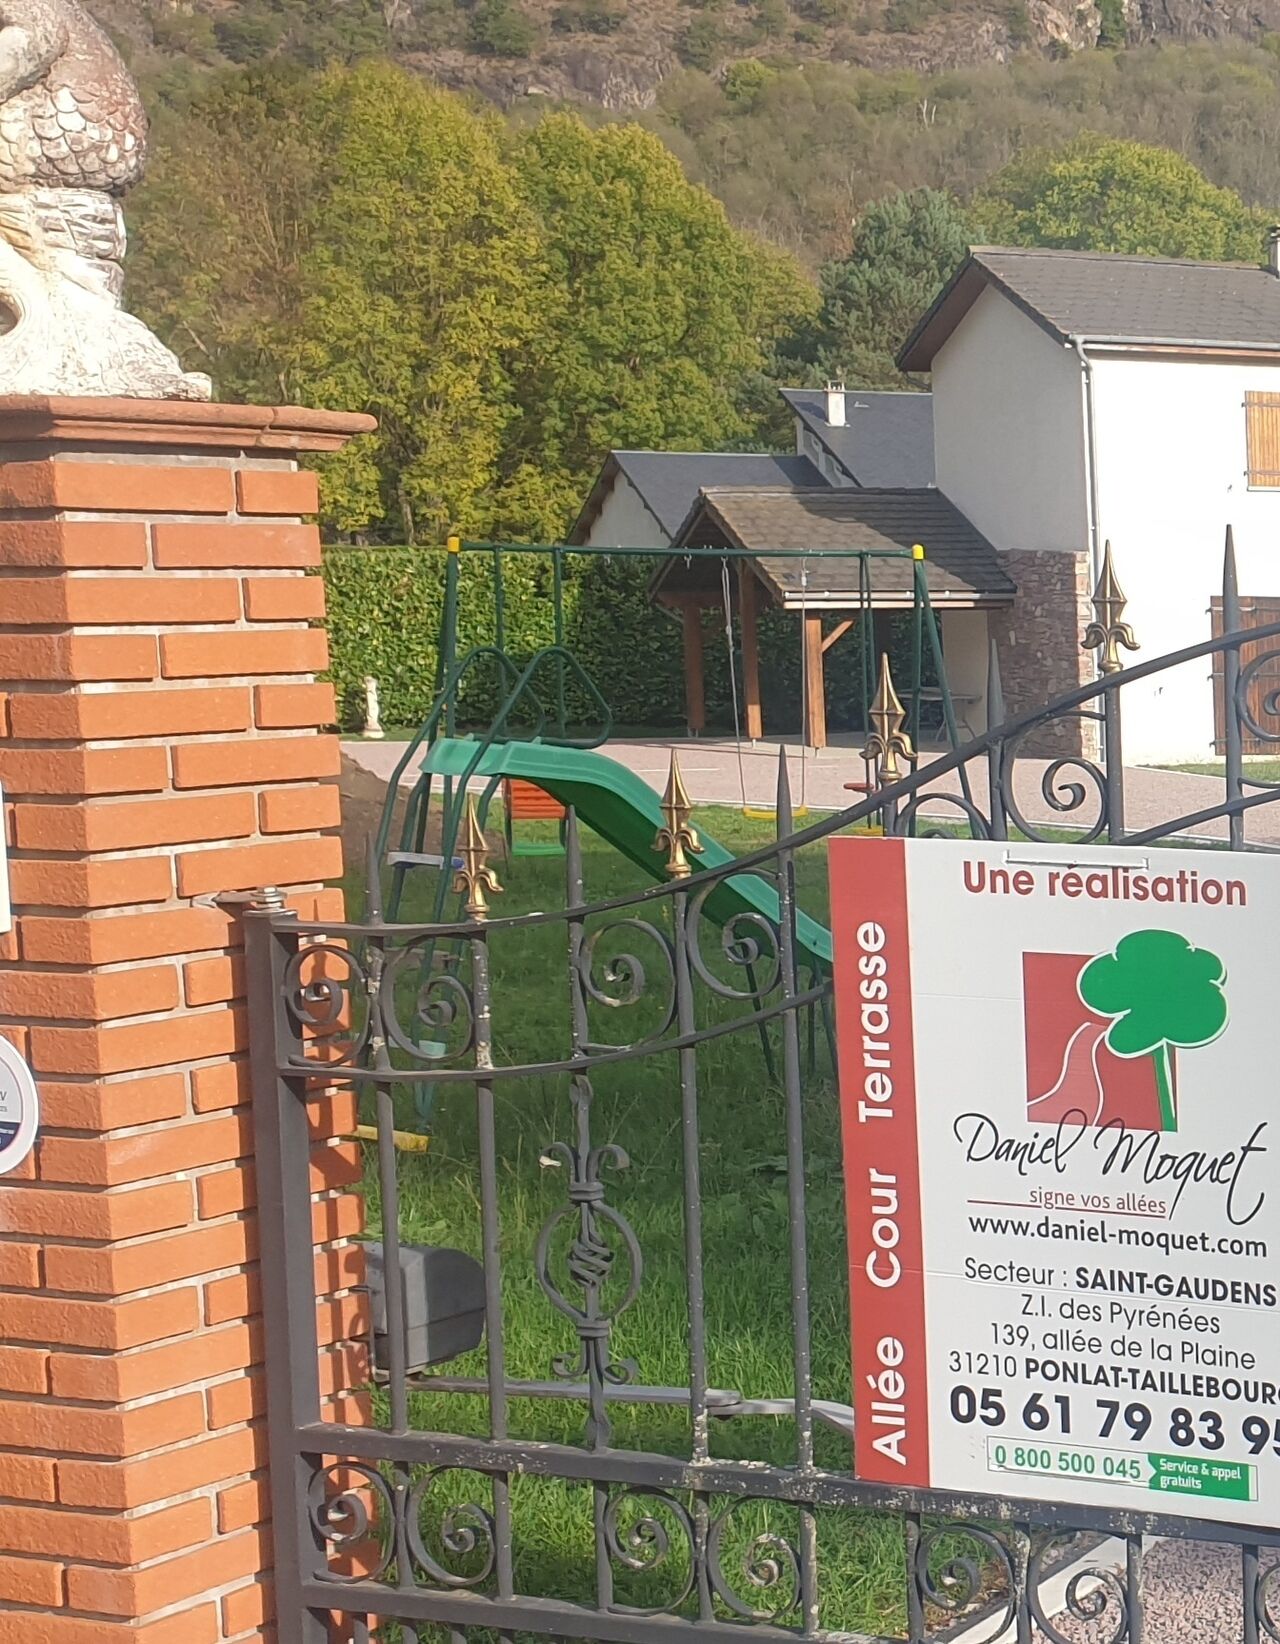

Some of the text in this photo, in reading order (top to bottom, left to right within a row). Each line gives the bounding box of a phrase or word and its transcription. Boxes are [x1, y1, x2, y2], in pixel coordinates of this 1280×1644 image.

[963, 861, 1246, 905] Une réalisation
[953, 1108, 1268, 1226] Daniel Moquet
[857, 921, 906, 1465] Allée Cour Terrasse
[1029, 1187, 1167, 1214] signe vos allées
[968, 1216, 1268, 1258] www.daniel-moquet.com
[965, 1257, 1055, 1287] Secteur
[1075, 1267, 1277, 1307] SAINT-GAUDENS
[1021, 1294, 1221, 1335] Z.I. des Pyrénées
[949, 1352, 1018, 1378] 31210
[991, 1323, 1256, 1370] 139, allée de la Plaine
[950, 1385, 1004, 1427] 05
[1022, 1393, 1071, 1434] 61
[1097, 1400, 1152, 1442] 79
[1169, 1407, 1225, 1451] 83
[994, 1445, 1141, 1480] 0 800 500 045
[1160, 1458, 1241, 1482] Service & appel
[1160, 1475, 1202, 1489] gratuits
